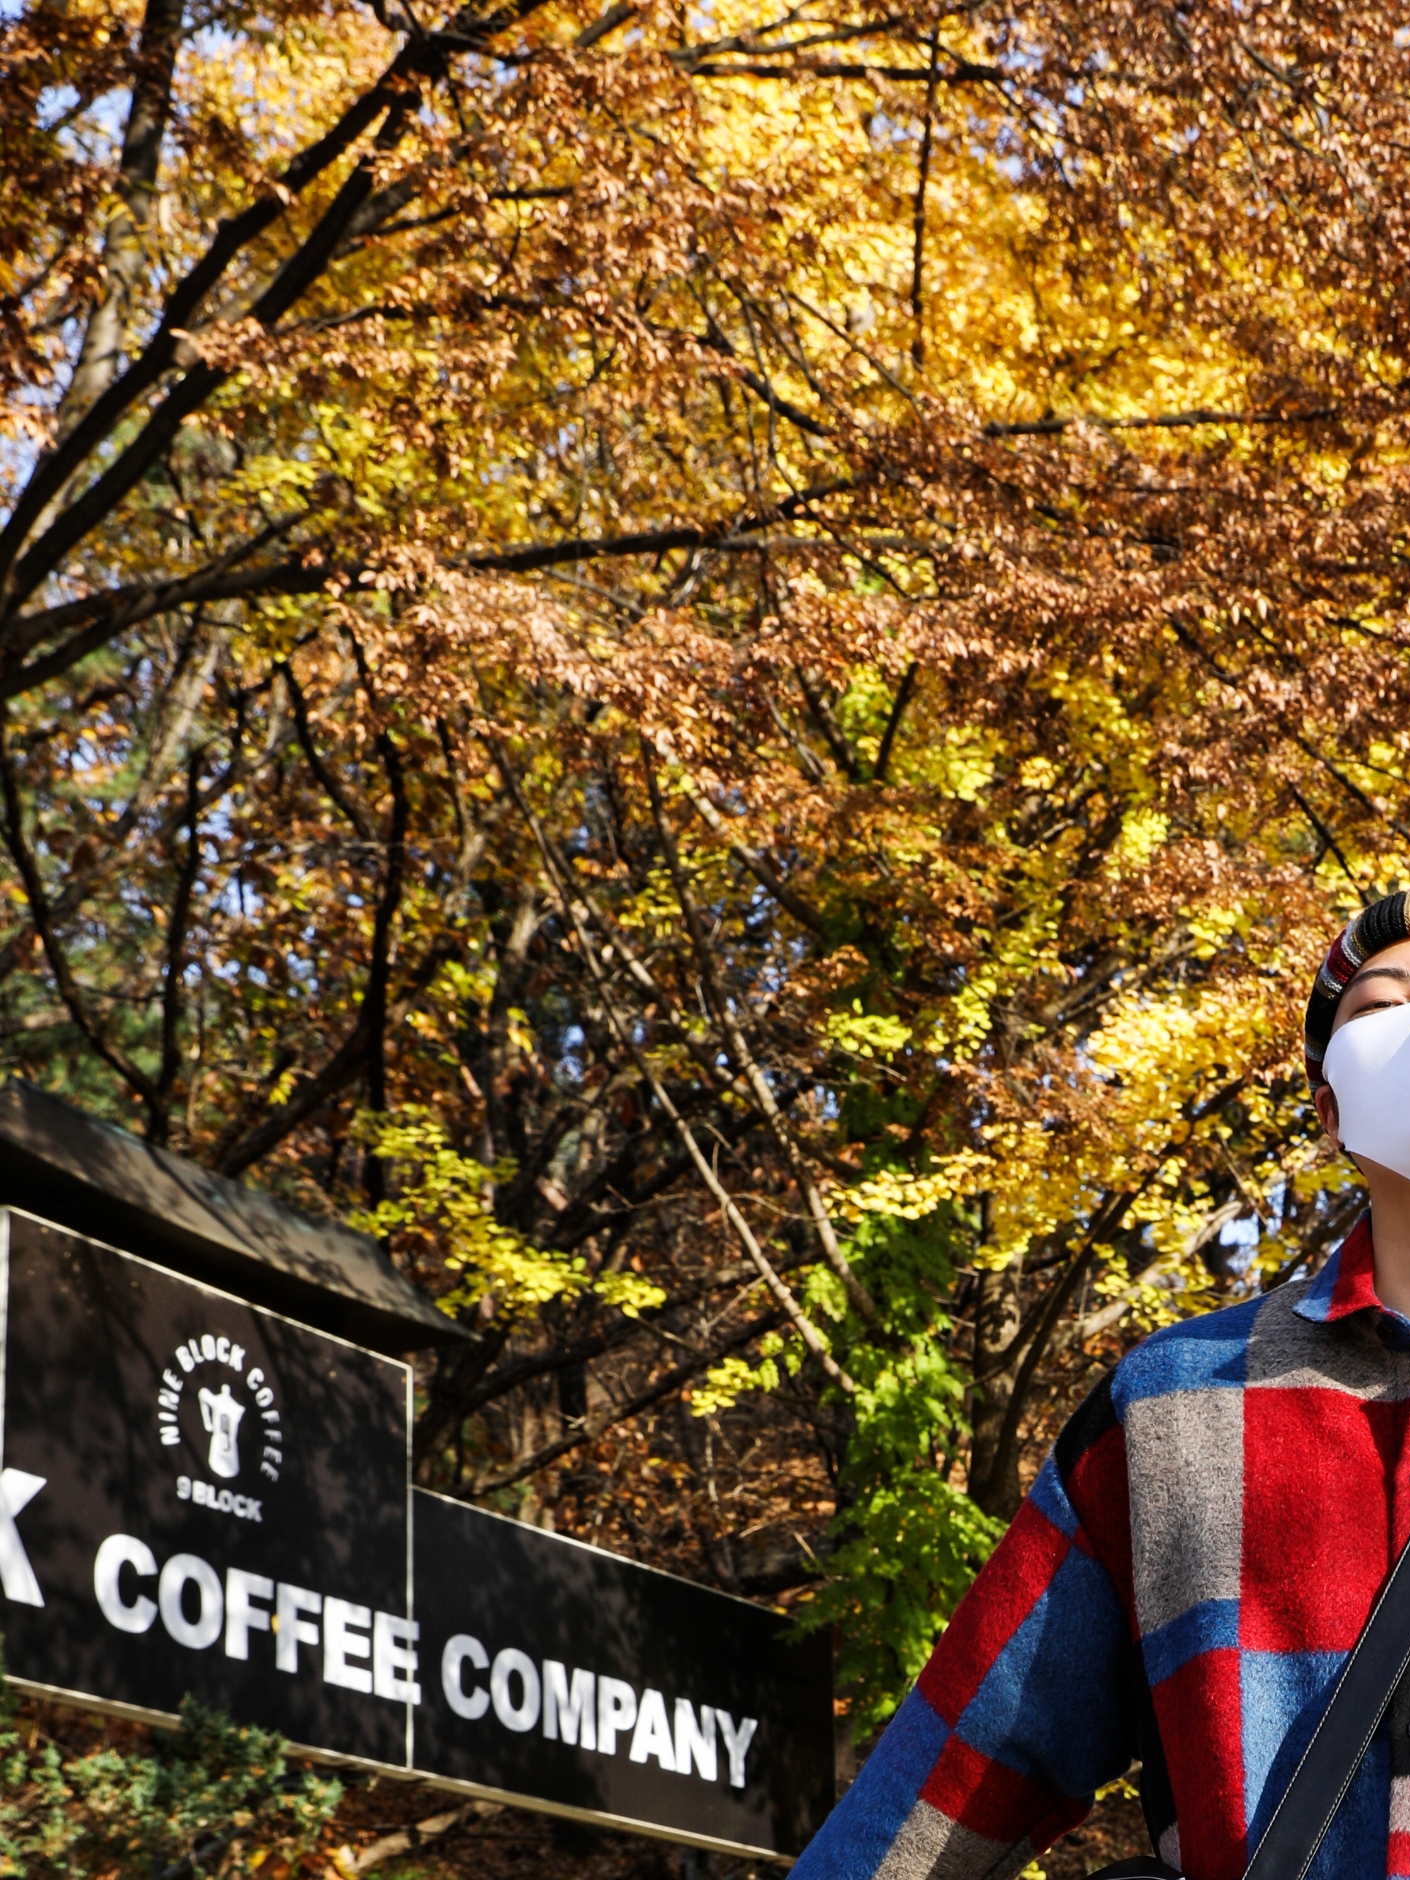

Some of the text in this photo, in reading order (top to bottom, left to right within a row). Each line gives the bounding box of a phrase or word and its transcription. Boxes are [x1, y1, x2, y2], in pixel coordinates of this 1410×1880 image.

[158, 1334, 283, 1482] NINE BLOCK COFFEE
[93, 1533, 422, 1706] COFFEE
[441, 1633, 758, 1788] COMPANY
